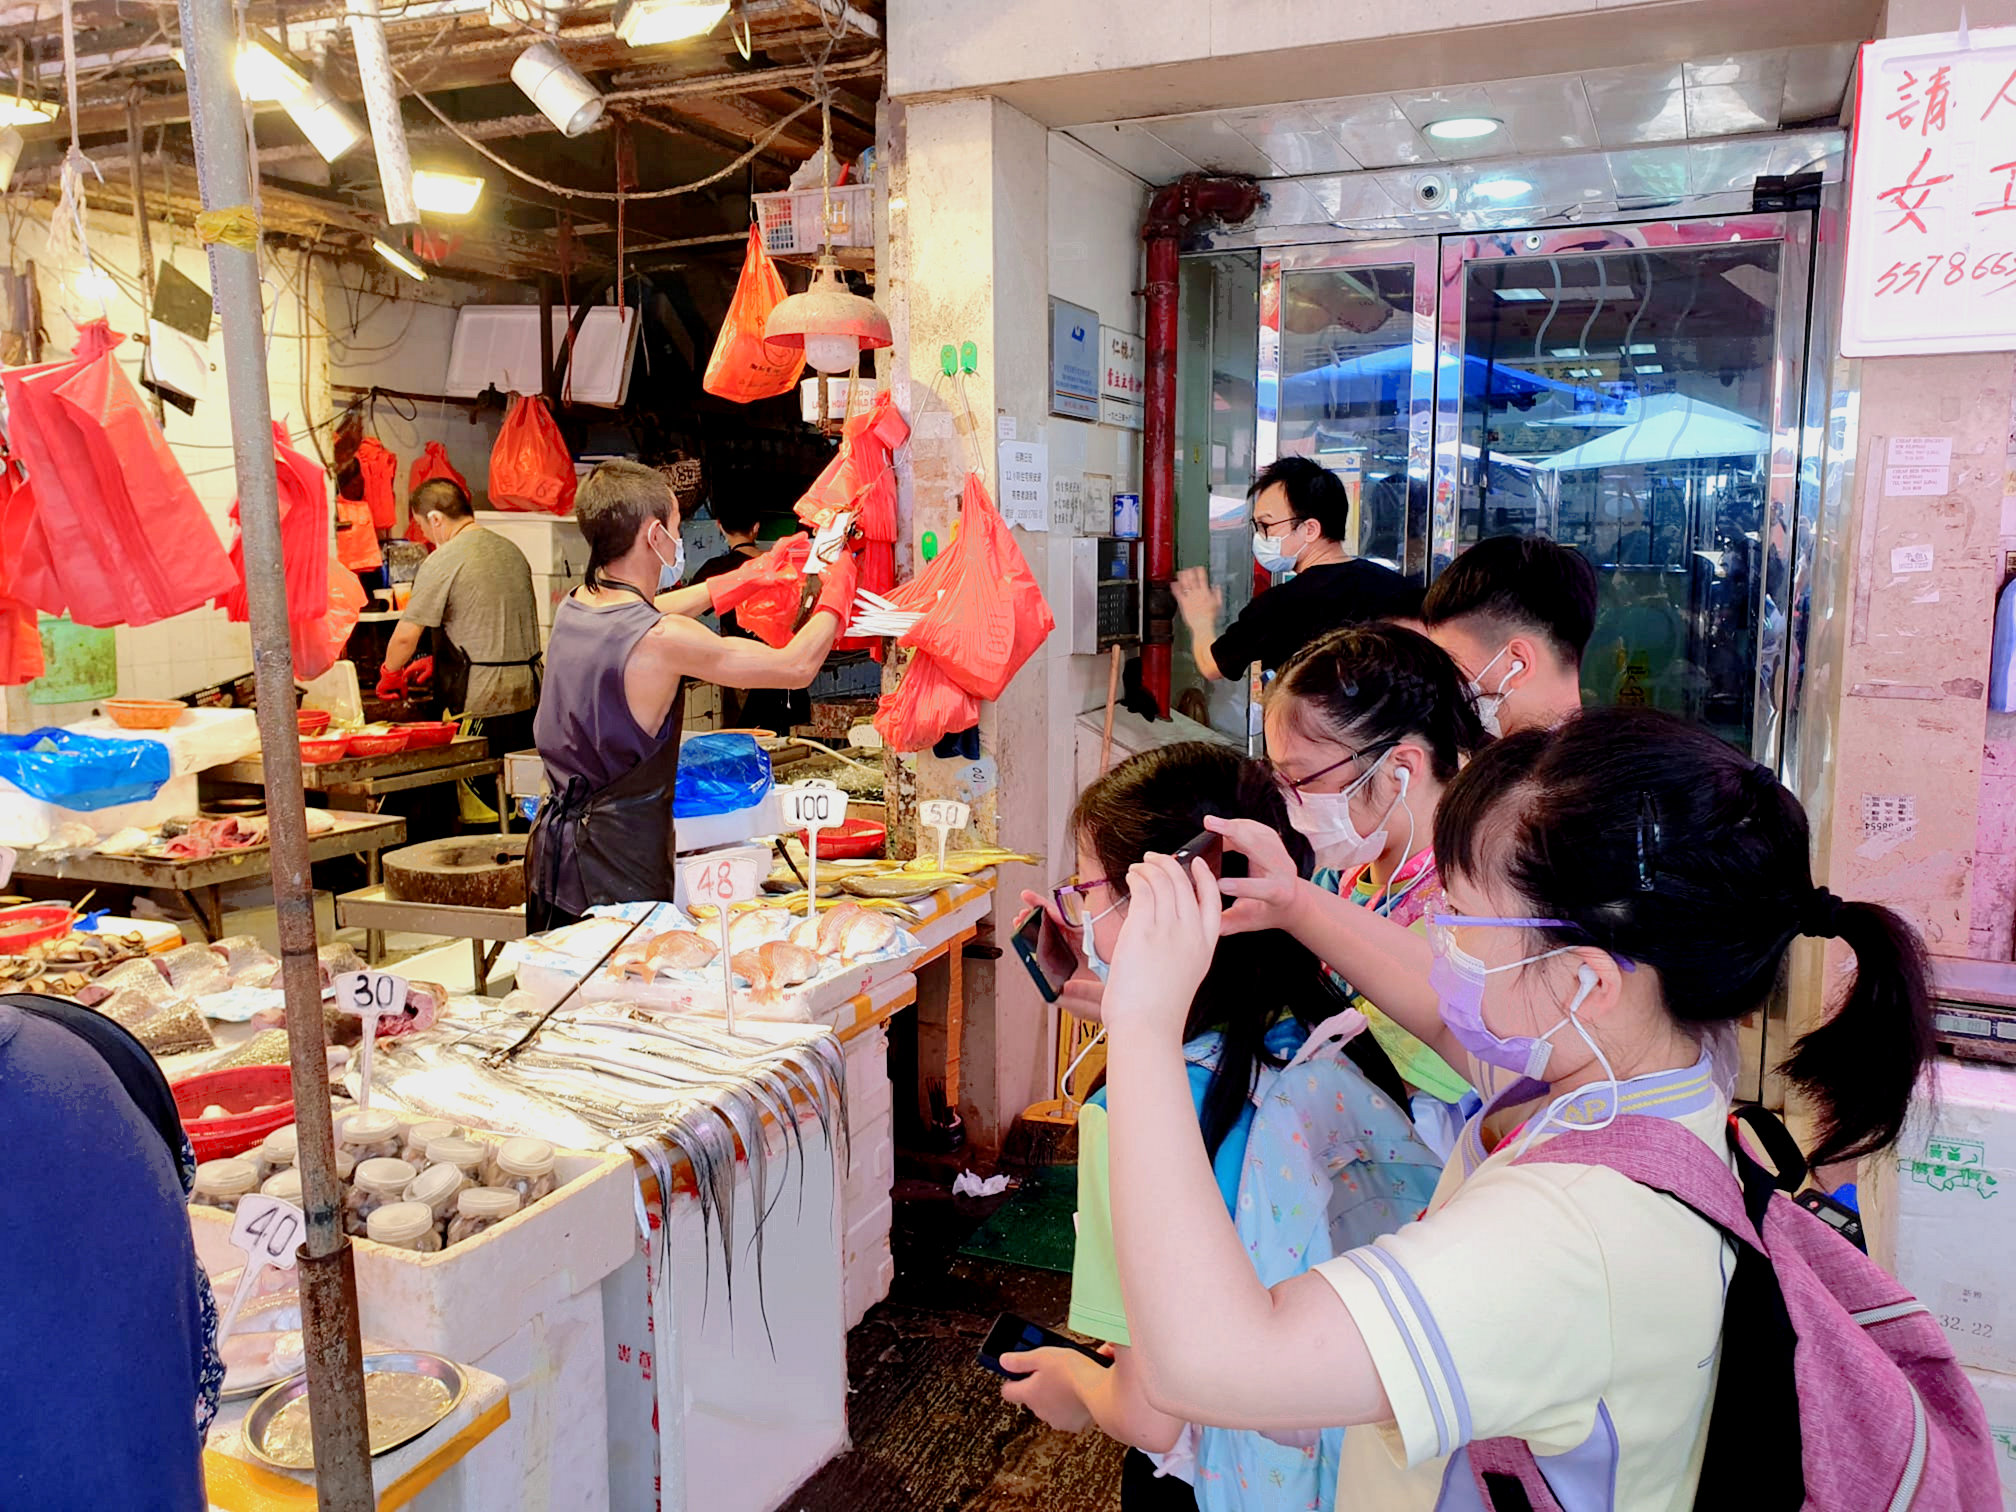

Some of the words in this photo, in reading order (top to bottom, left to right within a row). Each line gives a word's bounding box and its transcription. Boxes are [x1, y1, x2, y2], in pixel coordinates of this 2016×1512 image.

[795, 794, 829, 821] 100
[929, 803, 959, 826] 50
[697, 861, 734, 899] 48
[353, 974, 394, 1008] 30
[245, 1206, 298, 1257] 40
